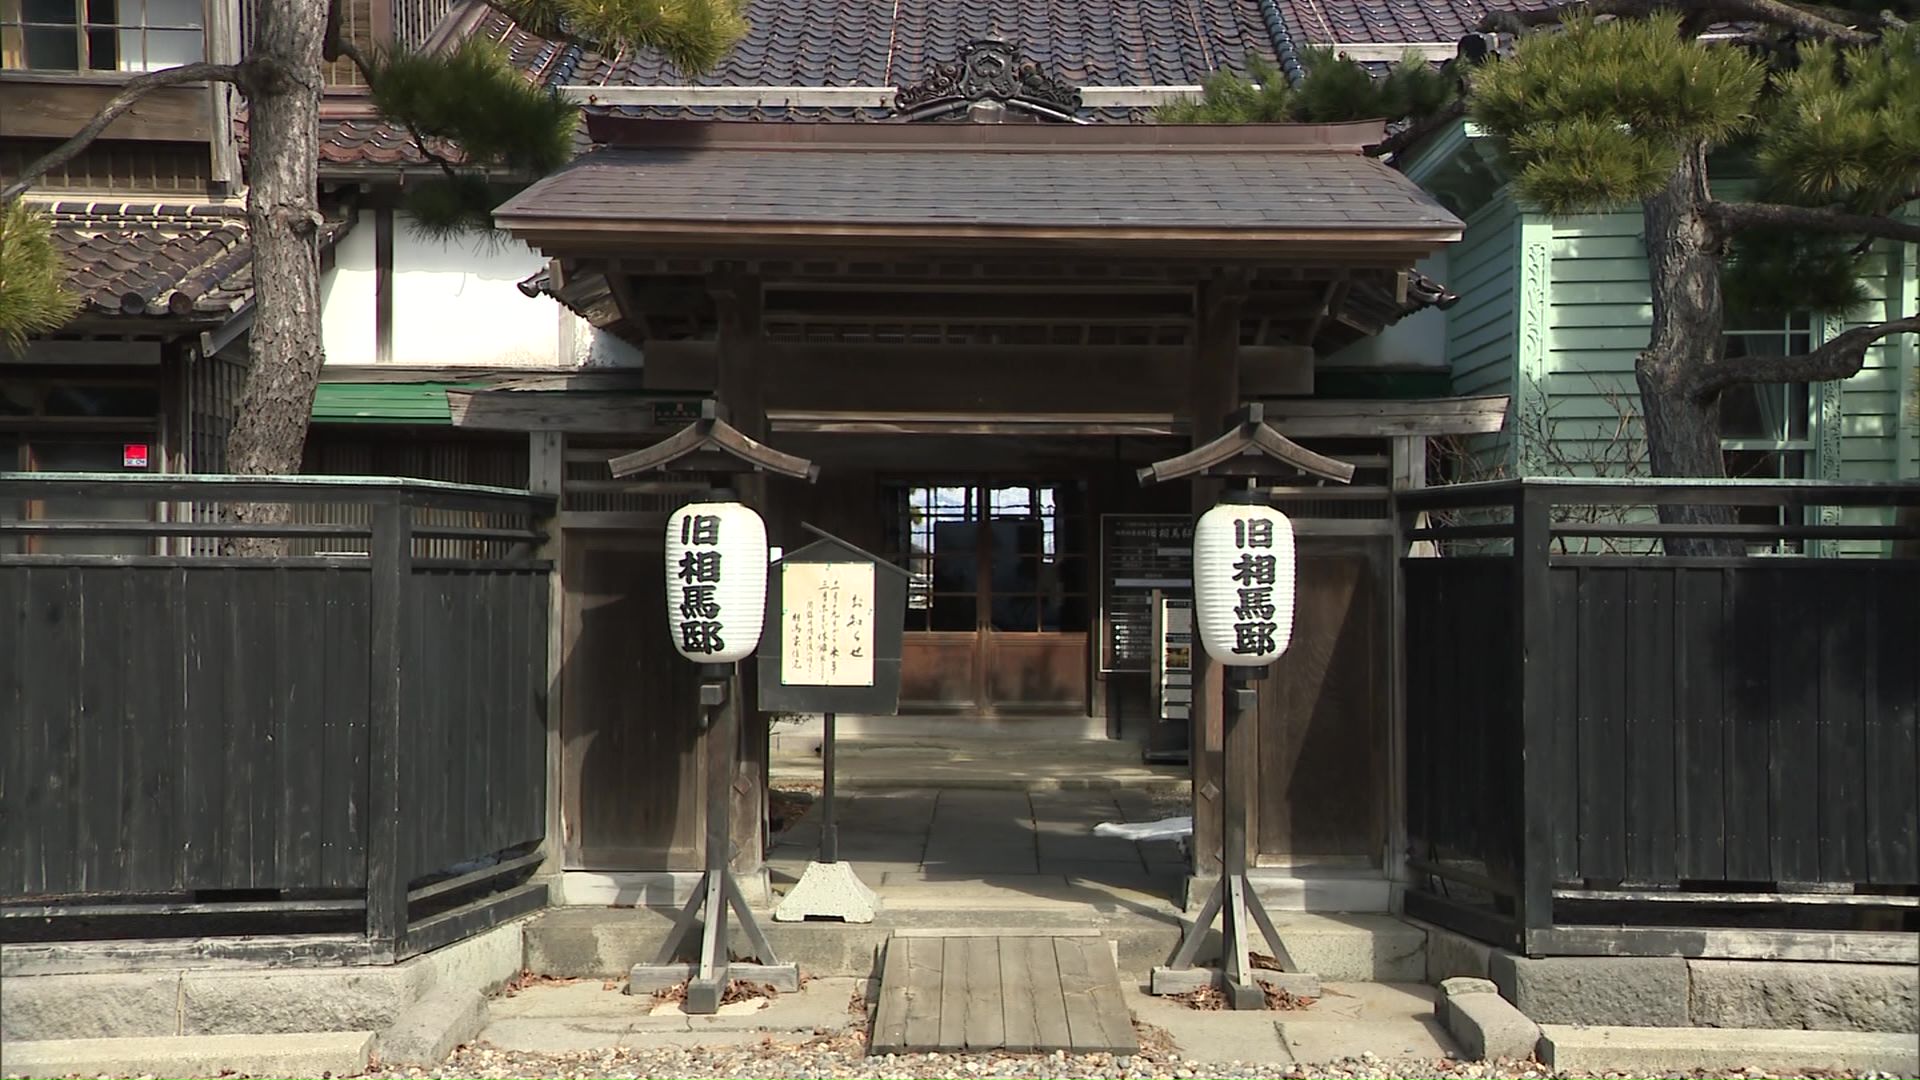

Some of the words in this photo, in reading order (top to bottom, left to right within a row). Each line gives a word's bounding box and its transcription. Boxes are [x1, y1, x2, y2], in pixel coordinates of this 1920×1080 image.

[678, 515, 725, 655] 旧相馬邸
[846, 594, 864, 658] お知らせ
[1232, 518, 1278, 656] 旧相馬邸
